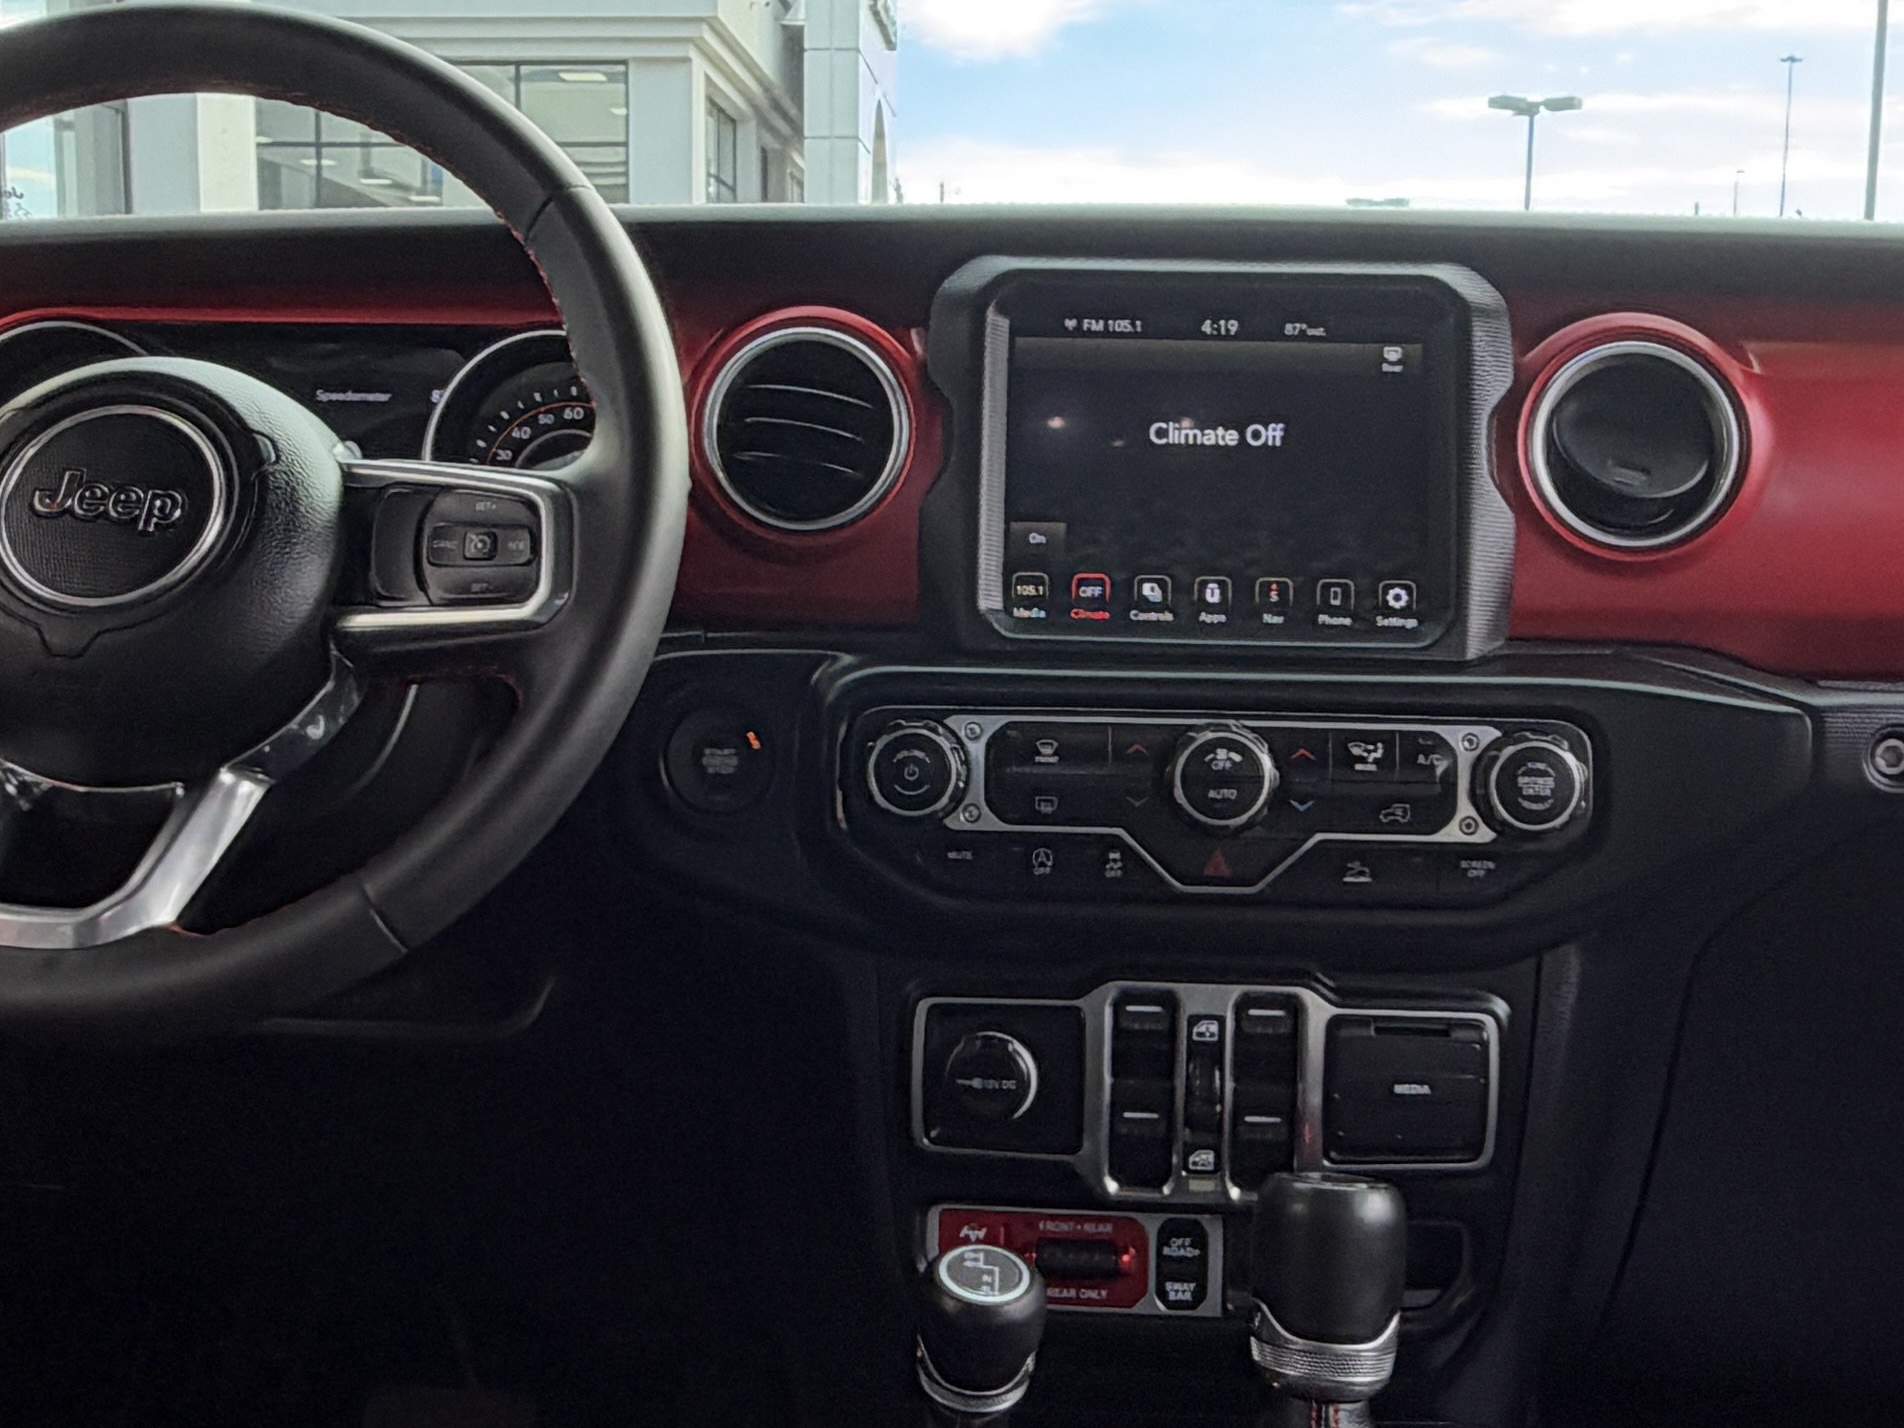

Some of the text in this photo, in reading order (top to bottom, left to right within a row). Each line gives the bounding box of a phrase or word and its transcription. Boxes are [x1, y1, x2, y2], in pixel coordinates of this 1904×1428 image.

[1082, 319, 1143, 334] FM 105.1
[1201, 319, 1239, 336] 4:19
[315, 389, 392, 403] Speedometer
[537, 412, 555, 425] 50
[563, 406, 584, 421] 60
[511, 425, 531, 440] 40
[1149, 422, 1284, 446] Climate Off
[31, 467, 189, 532] Jeep
[1028, 532, 1046, 545] On
[1016, 585, 1044, 596] 105.1
[1079, 585, 1103, 599] OFF
[1013, 608, 1046, 618] Media
[1071, 609, 1110, 620] Climate
[1130, 610, 1173, 622] Controls
[1199, 613, 1226, 624] Apps
[1263, 613, 1284, 624] Nav
[1318, 614, 1351, 626] Phone
[1376, 615, 1418, 628] Settings
[1417, 754, 1442, 764] A/C
[1211, 761, 1232, 771] OFF
[1208, 789, 1238, 799] AUTO
[1033, 867, 1051, 875] OFF
[1170, 1238, 1191, 1248] OFF
[1164, 1282, 1196, 1292] SWAY
[1079, 1288, 1108, 1300] ONLY
[1169, 1292, 1192, 1301] BAR
